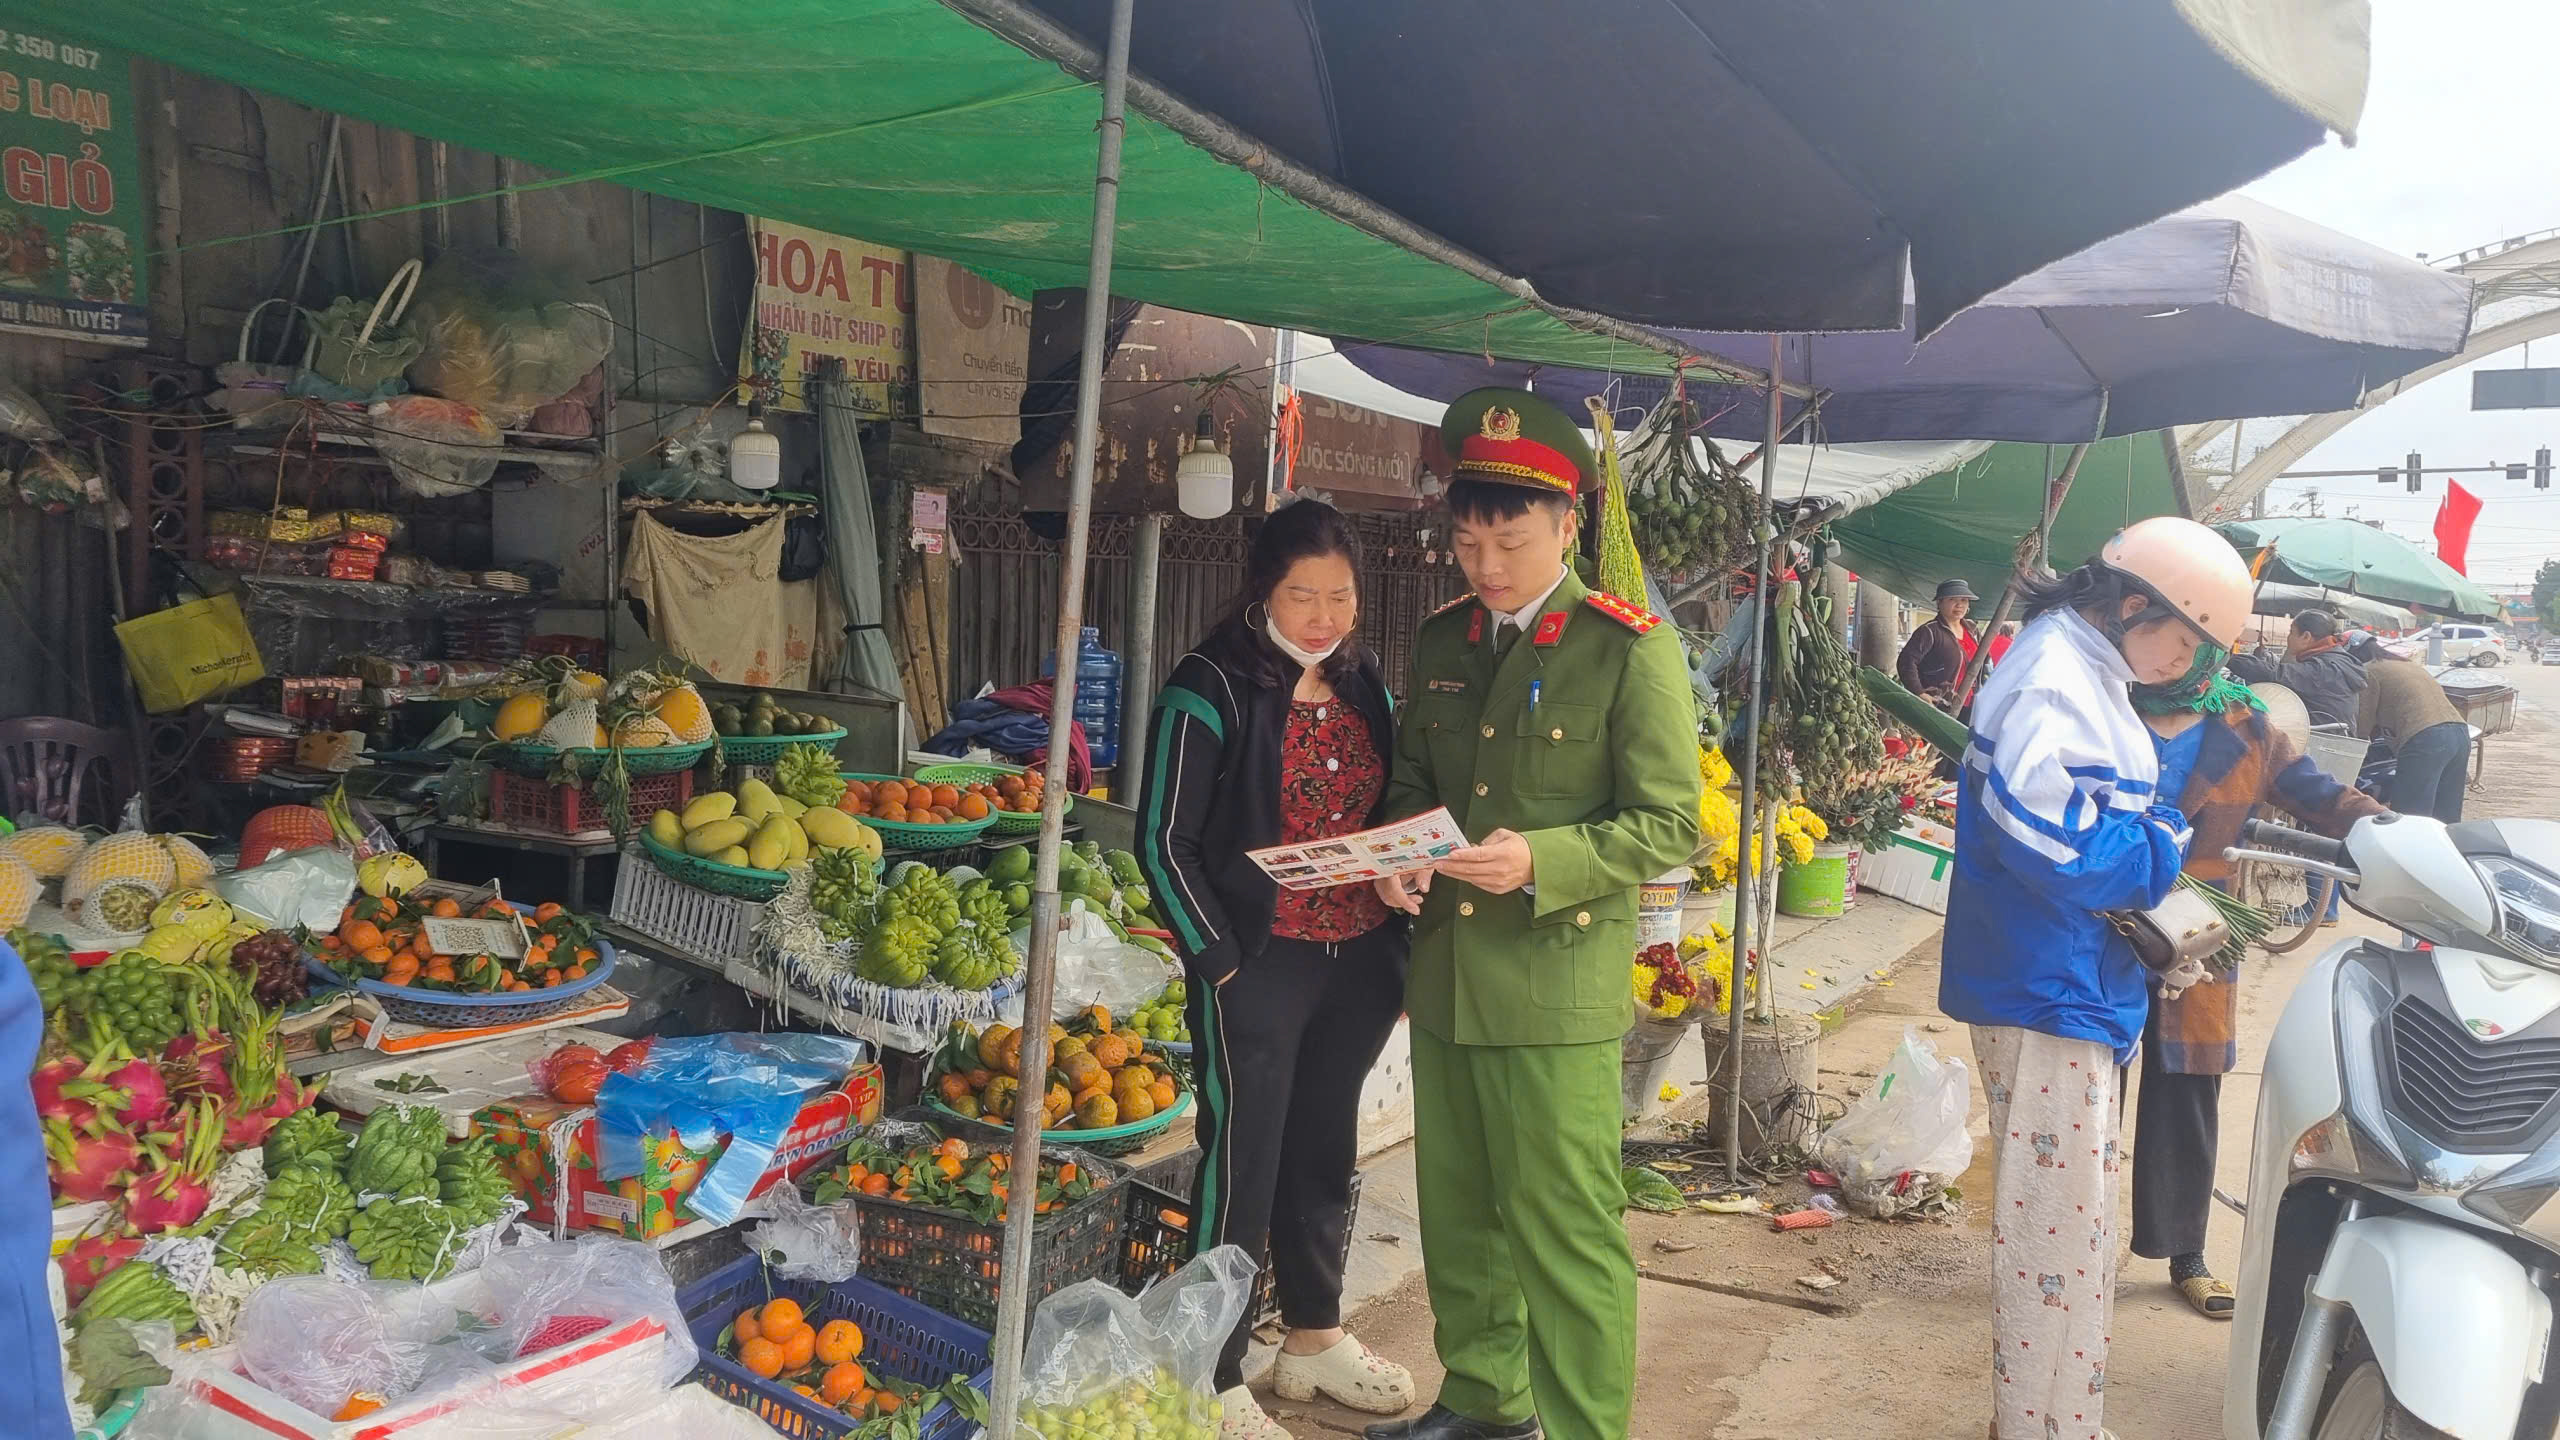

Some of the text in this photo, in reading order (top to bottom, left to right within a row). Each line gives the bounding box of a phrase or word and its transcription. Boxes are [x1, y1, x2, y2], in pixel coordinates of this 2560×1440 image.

[60, 44, 99, 71] 067
[28, 77, 111, 135] LOẠI
[3, 142, 114, 215] GIỎ
[755, 231, 851, 303] HOA
[65, 306, 122, 330] TUYẾT
[848, 319, 887, 347] SHIP
[801, 350, 848, 378] THO
[855, 356, 890, 383] YÊU
[1335, 440, 1376, 476] SỐNG
